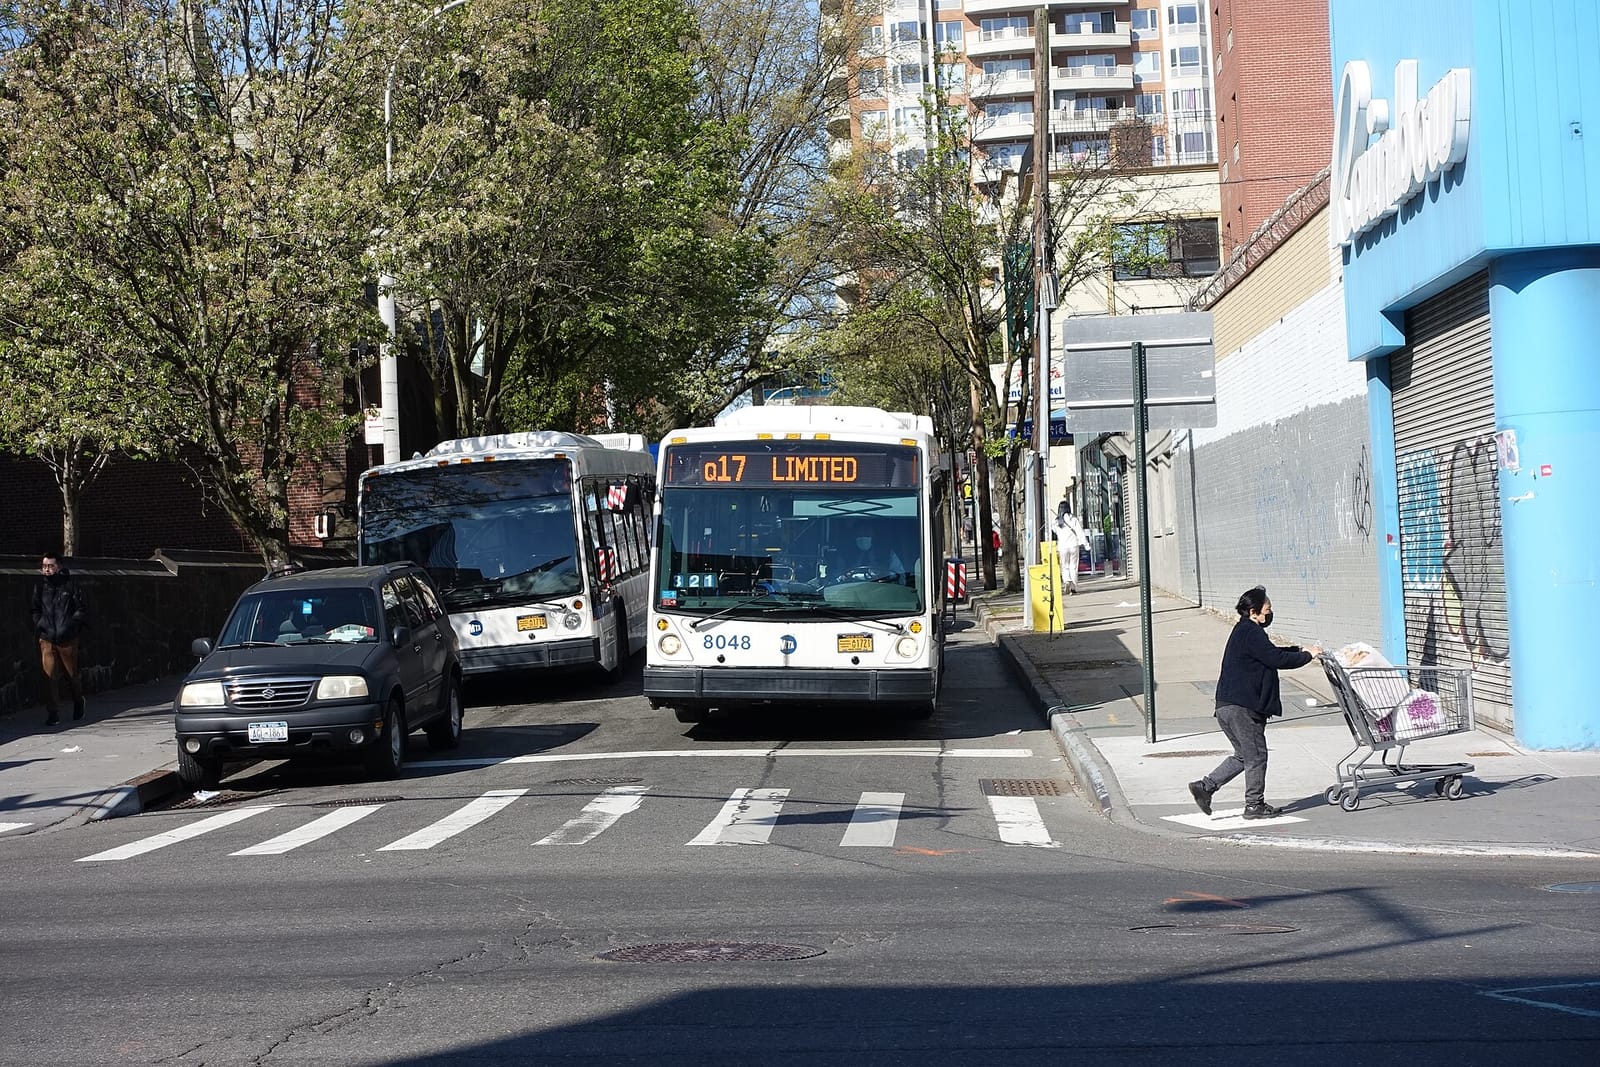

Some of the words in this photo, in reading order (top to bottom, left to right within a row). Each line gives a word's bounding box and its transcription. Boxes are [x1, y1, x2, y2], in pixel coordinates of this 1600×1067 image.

[704, 455, 747, 482] Q17
[772, 456, 858, 482] LIMITED
[703, 634, 751, 650] 8048
